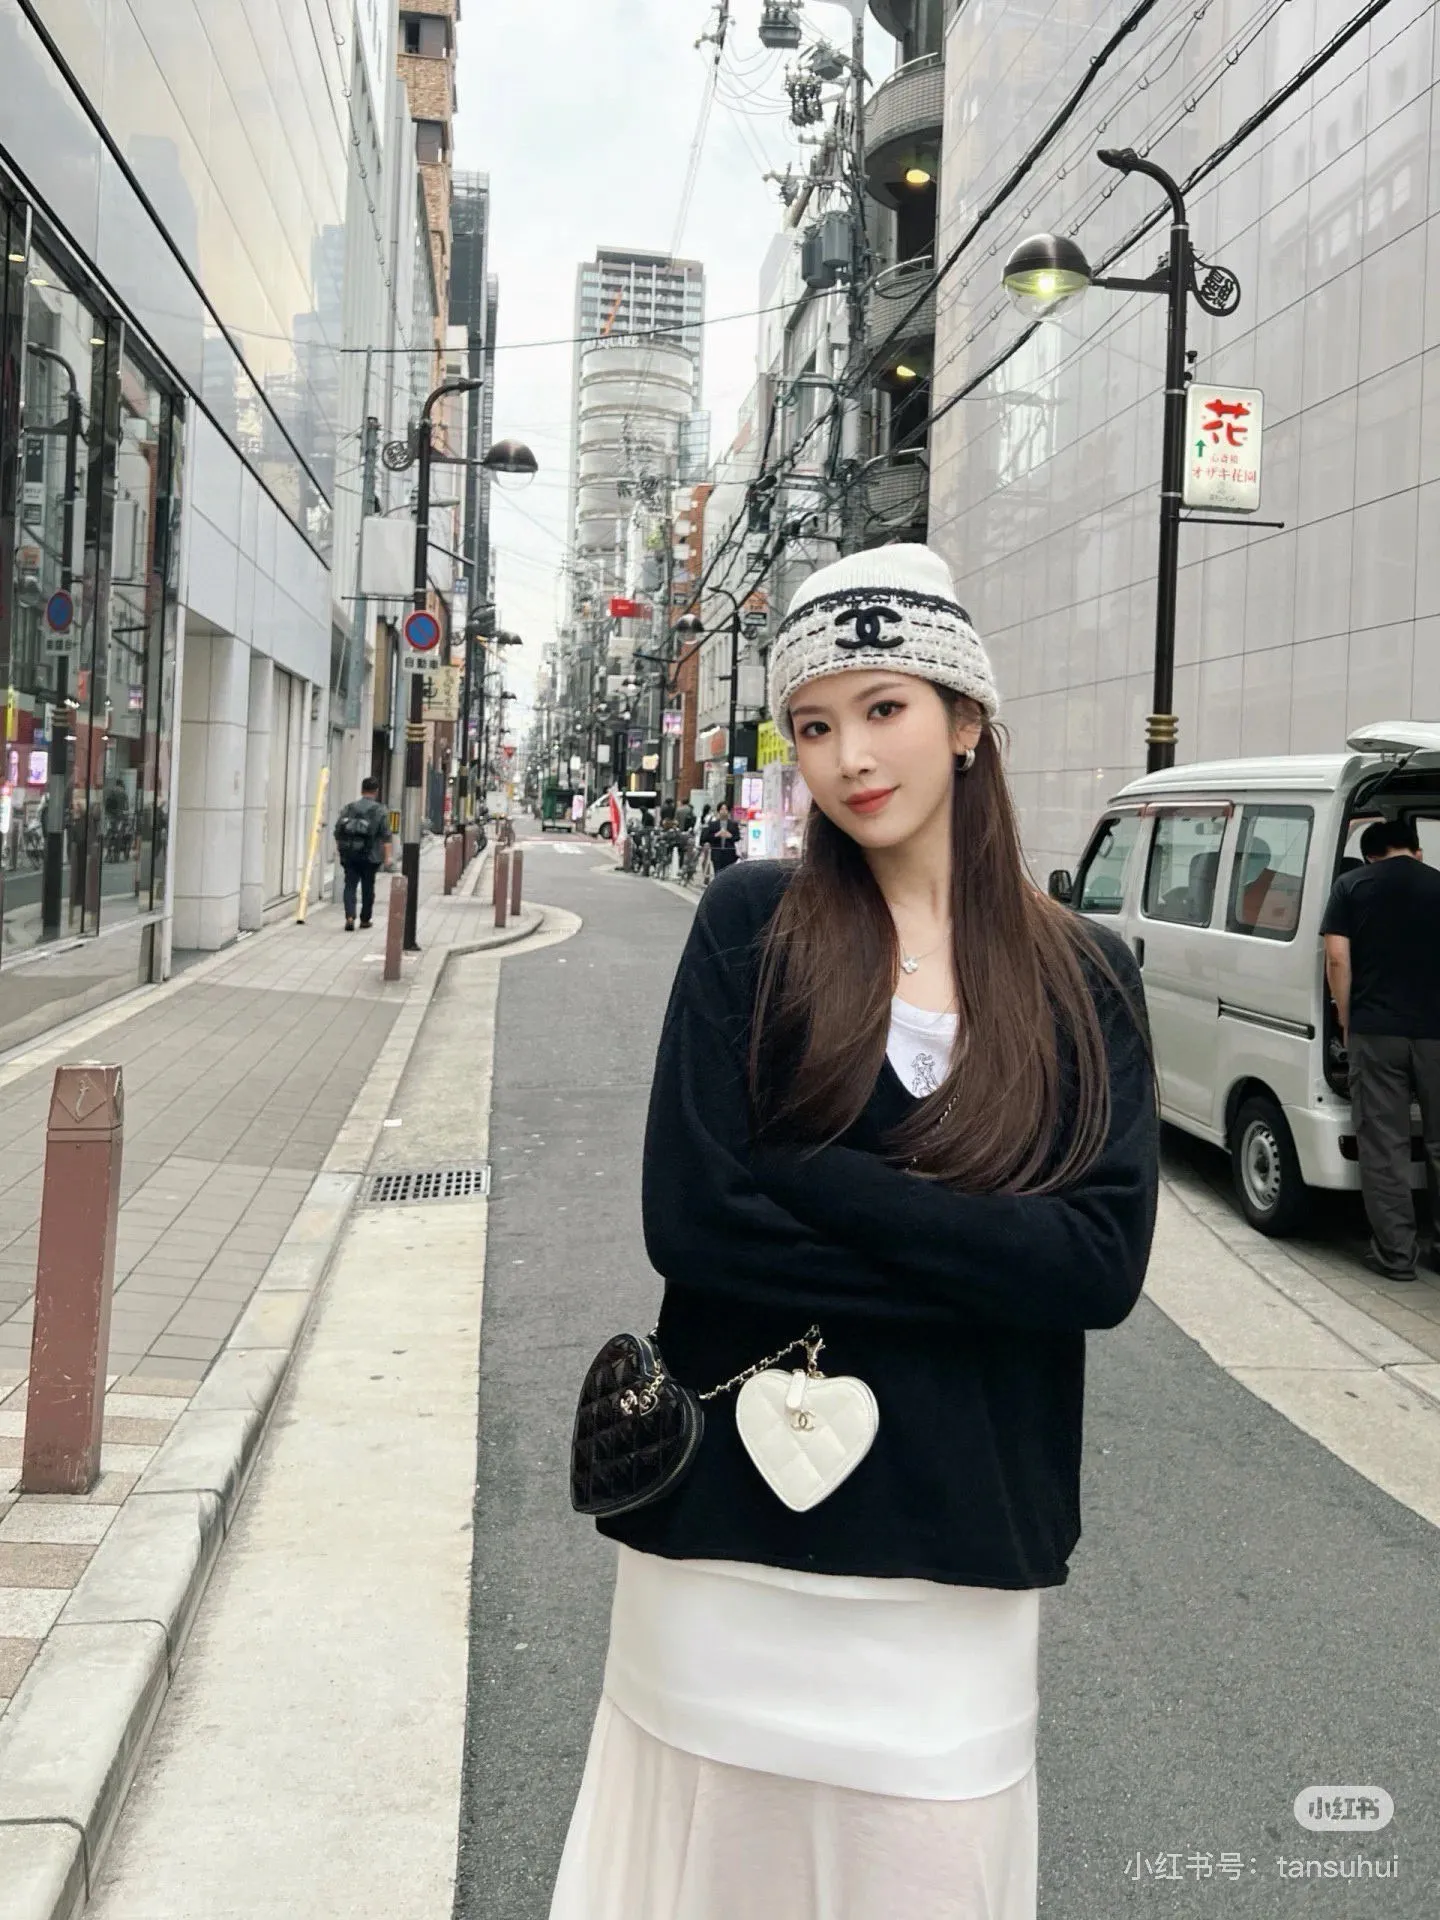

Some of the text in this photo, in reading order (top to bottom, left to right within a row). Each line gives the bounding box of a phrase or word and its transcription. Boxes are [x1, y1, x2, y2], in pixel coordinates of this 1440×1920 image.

[1202, 398, 1251, 447] 花
[404, 656, 439, 669] 自動車
